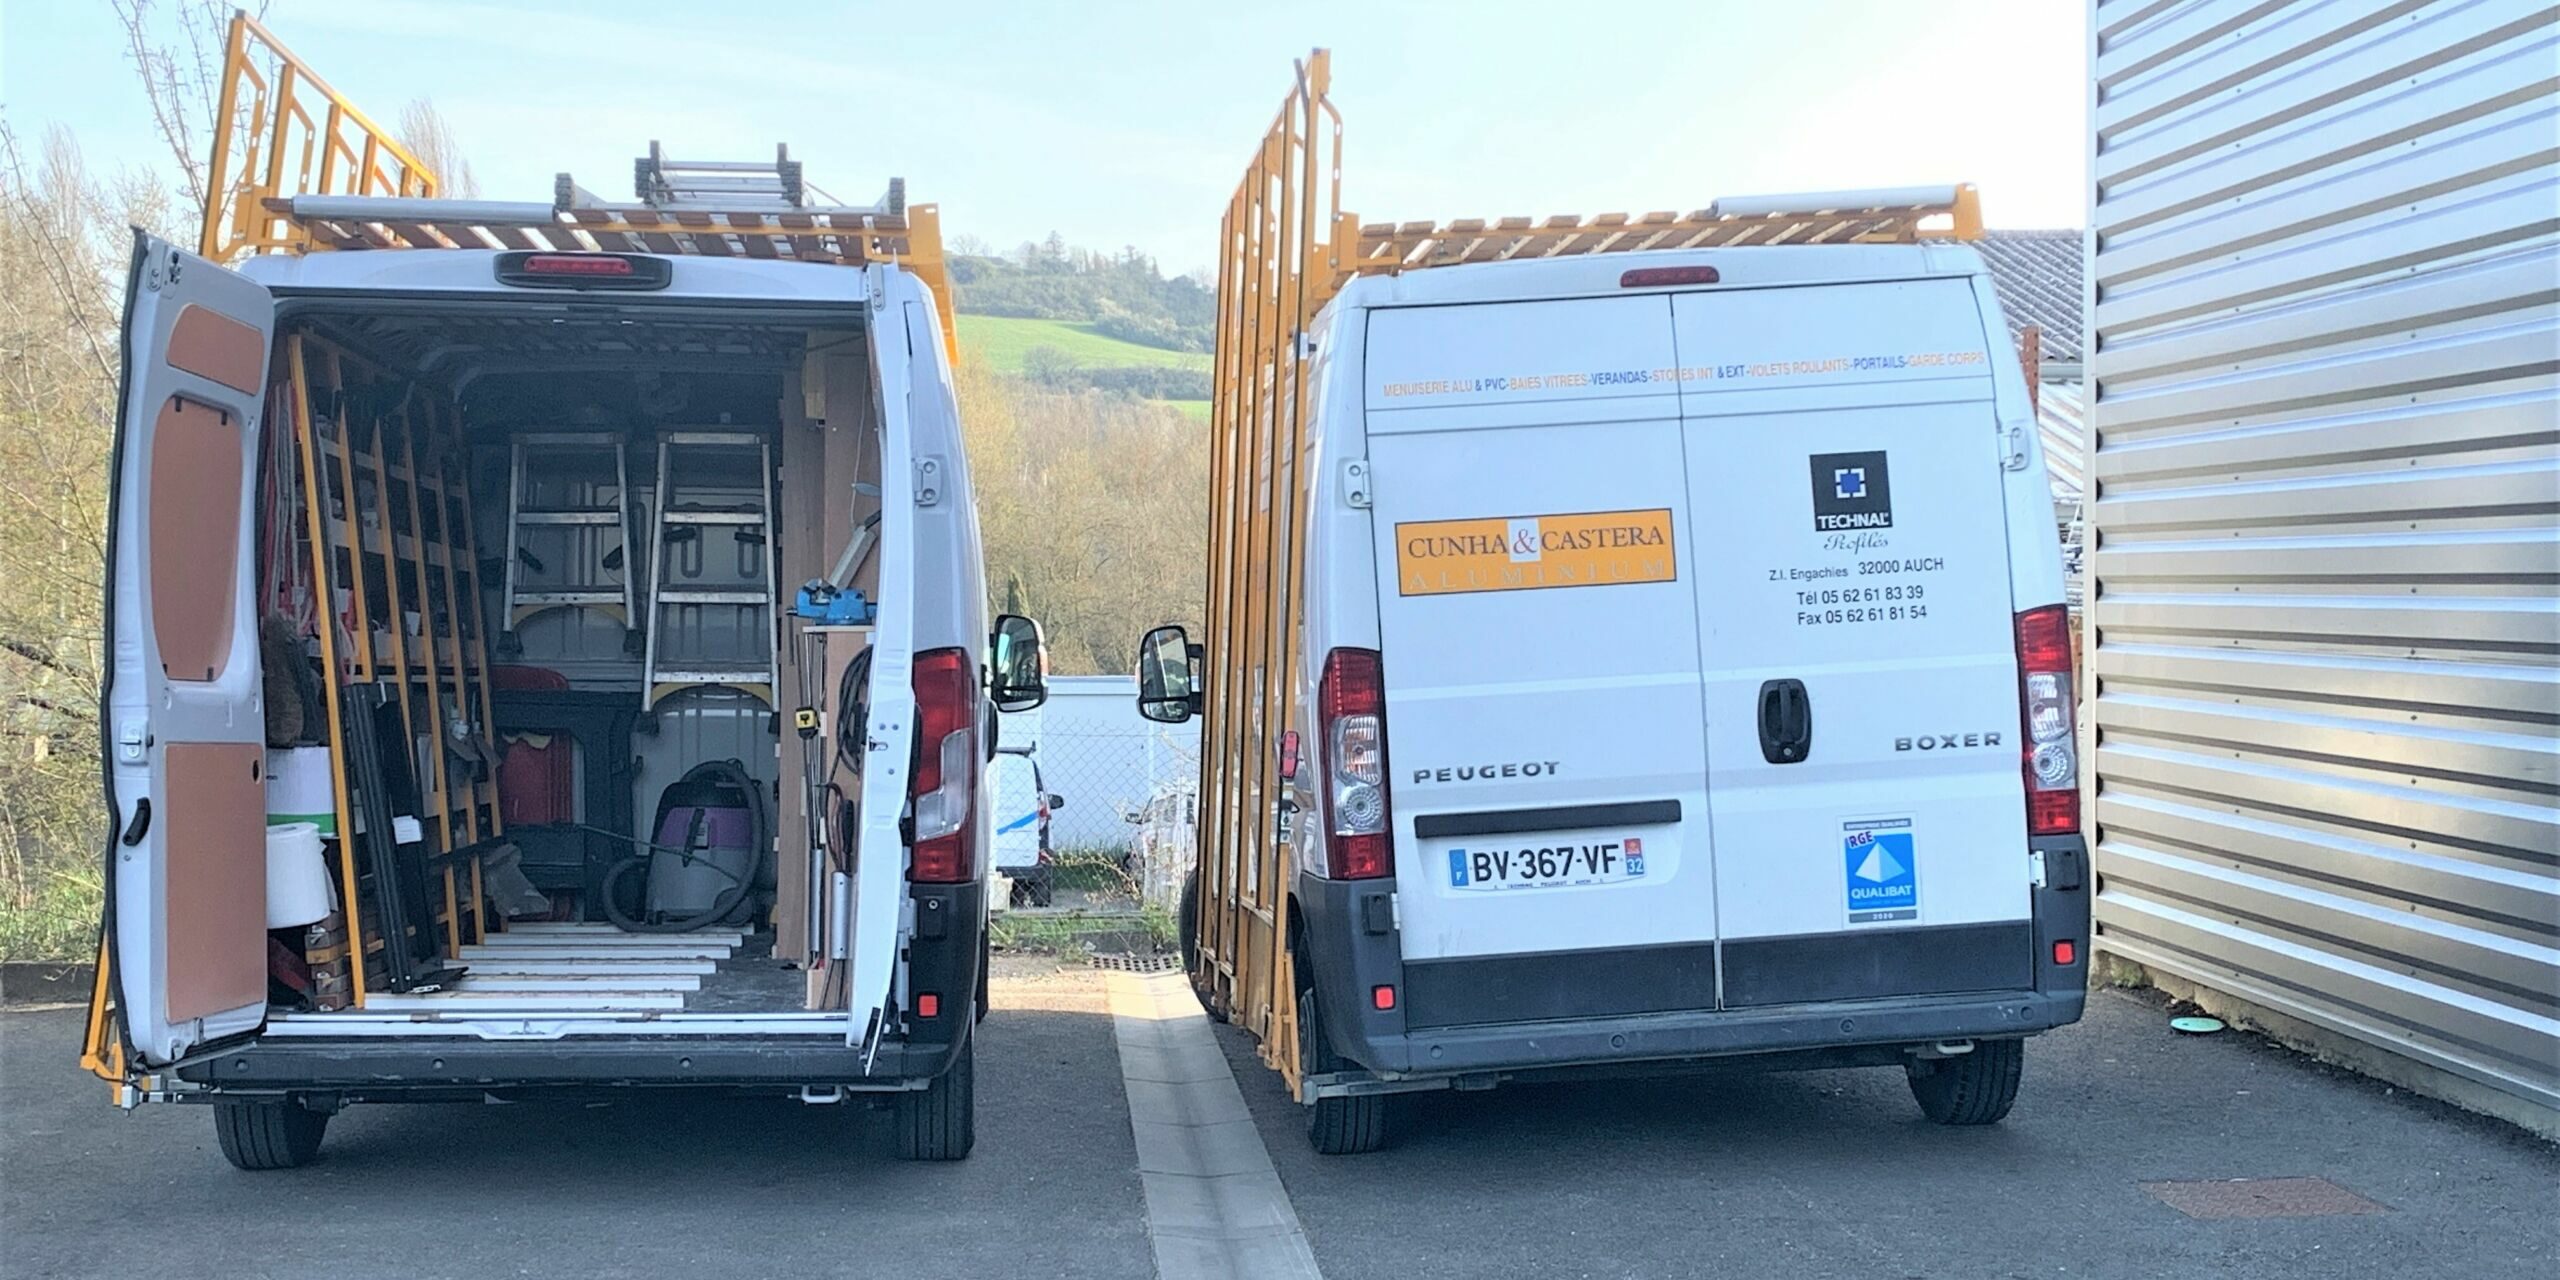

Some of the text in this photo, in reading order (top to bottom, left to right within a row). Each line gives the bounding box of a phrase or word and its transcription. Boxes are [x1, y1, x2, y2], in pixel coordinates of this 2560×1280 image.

[1384, 381, 1449, 396] MENUISERIE
[1452, 379, 1472, 393] ALU
[1475, 379, 1482, 391] &
[1947, 352, 1984, 365] CORPS
[1408, 526, 1665, 558] CUNHA & CASTERA
[1409, 560, 1665, 590] ALUMINIUM
[1791, 567, 1849, 582] Engachies
[1858, 560, 1899, 575] 32000
[1904, 558, 1944, 572] AUCH
[1797, 585, 1923, 605] Tél 05 62 61 83 39
[1798, 605, 1927, 625] Fax 05 62 61 81 54
[1895, 731, 2001, 751] BOXER
[1414, 761, 1560, 784] PEUGEOT
[1848, 831, 1874, 848] RGE
[1456, 844, 1644, 882] F BV-367-VF 32
[1851, 885, 1912, 899] QUALIBAT
